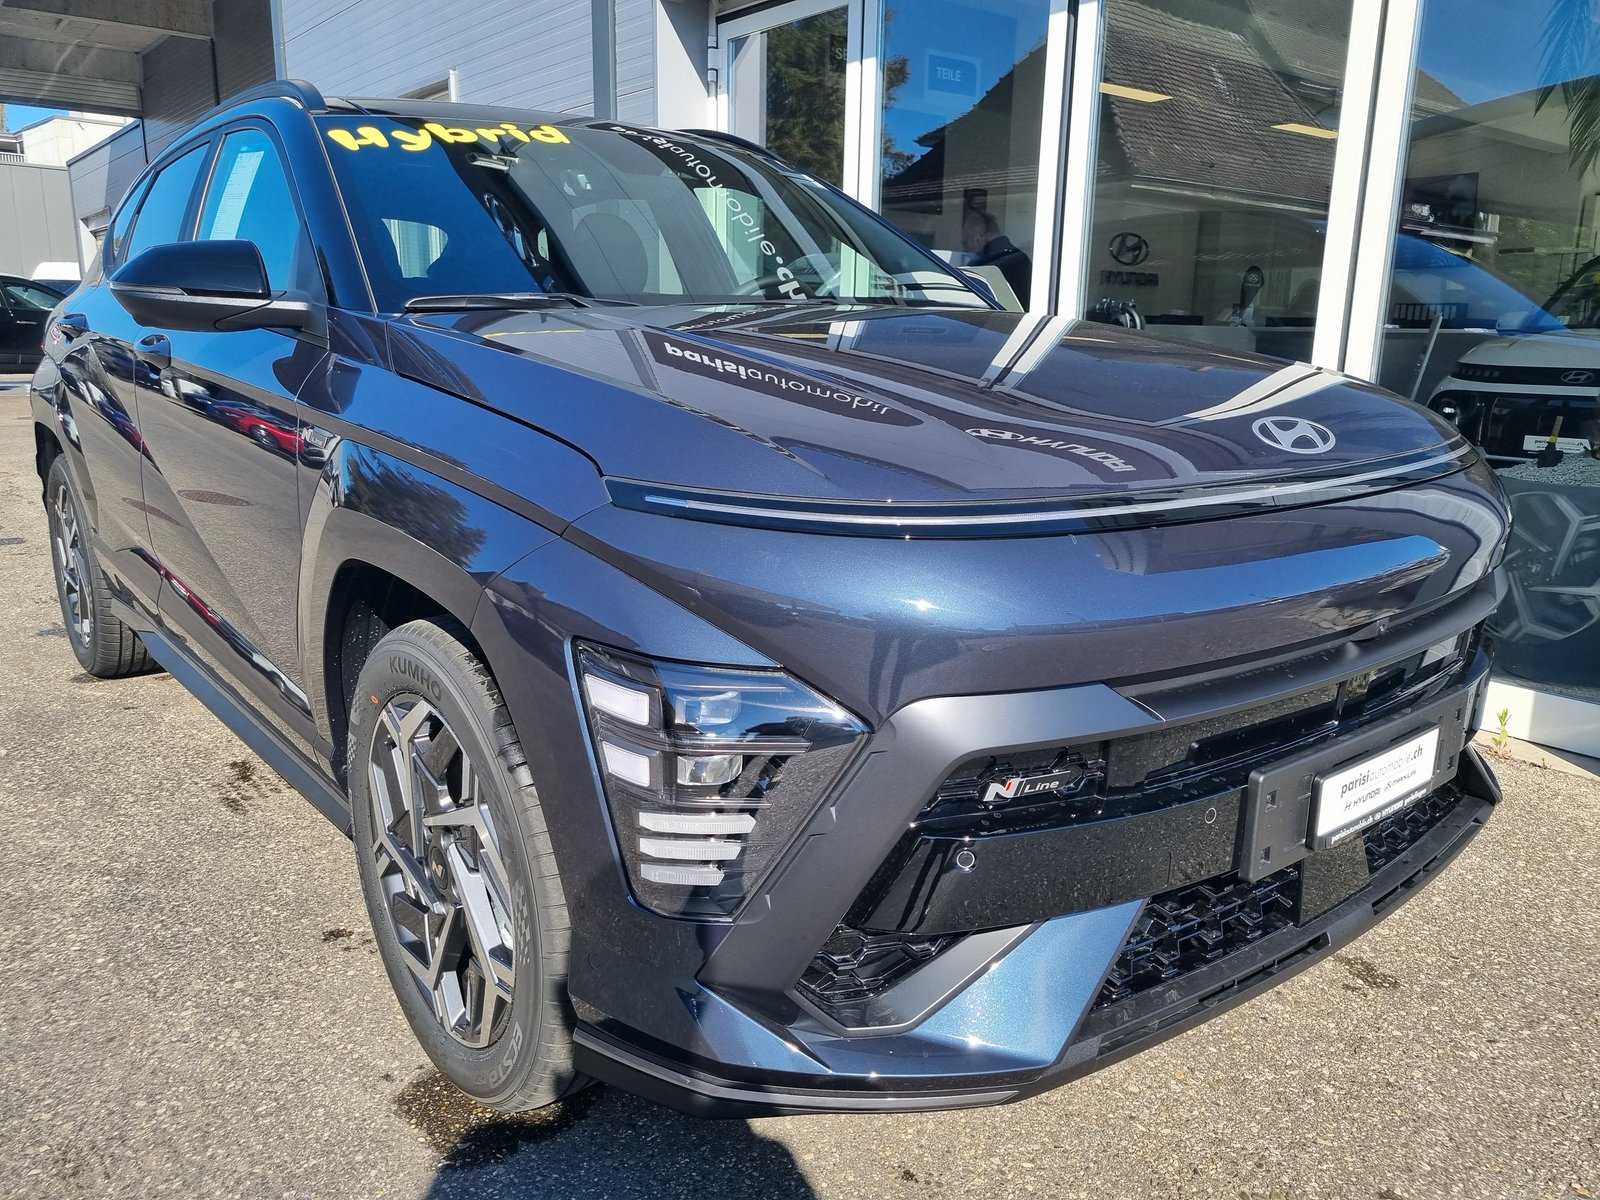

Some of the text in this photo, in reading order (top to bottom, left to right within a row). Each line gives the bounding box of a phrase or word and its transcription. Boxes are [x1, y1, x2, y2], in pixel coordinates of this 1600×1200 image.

[936, 66, 962, 82] TEILE
[327, 123, 571, 151] Hybrid
[1100, 270, 1160, 288] HYUNDAI
[389, 656, 442, 702] KUMHO
[1024, 780, 1060, 794] Line
[1353, 787, 1381, 806] HYUNDAI
